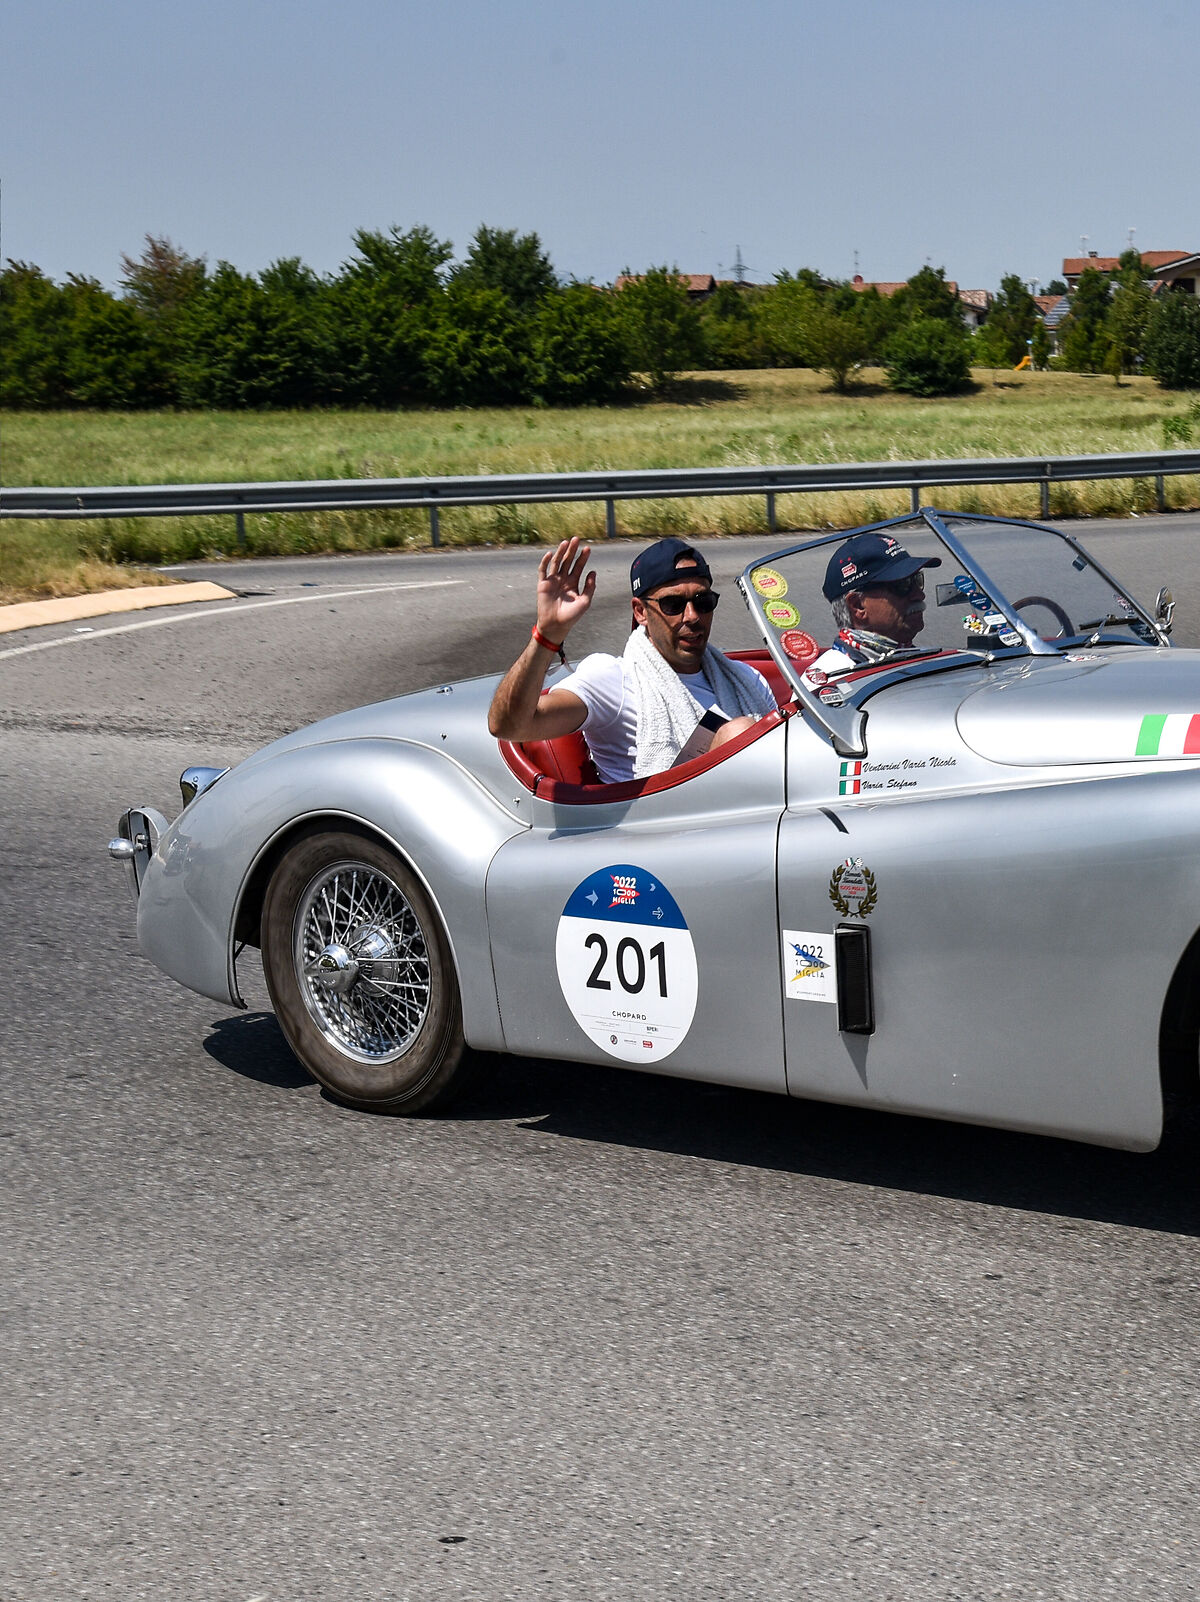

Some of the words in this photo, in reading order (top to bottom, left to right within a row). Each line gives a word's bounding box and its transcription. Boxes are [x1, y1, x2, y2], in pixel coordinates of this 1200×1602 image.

[840, 570, 868, 587] CHOPARD
[862, 762, 901, 773] Venturini
[901, 759, 926, 770] Varia
[928, 756, 957, 768] Nicola
[861, 780, 884, 790] Varia
[886, 778, 918, 790] Stefano
[613, 876, 637, 889] 2022
[612, 888, 636, 897] 1000
[612, 896, 636, 905] MIGLIA
[794, 943, 824, 959] 2022
[584, 932, 668, 998] 201
[795, 959, 825, 969] 1000
[795, 969, 825, 978] MIGLIA
[611, 1010, 647, 1021] CHOPARD
